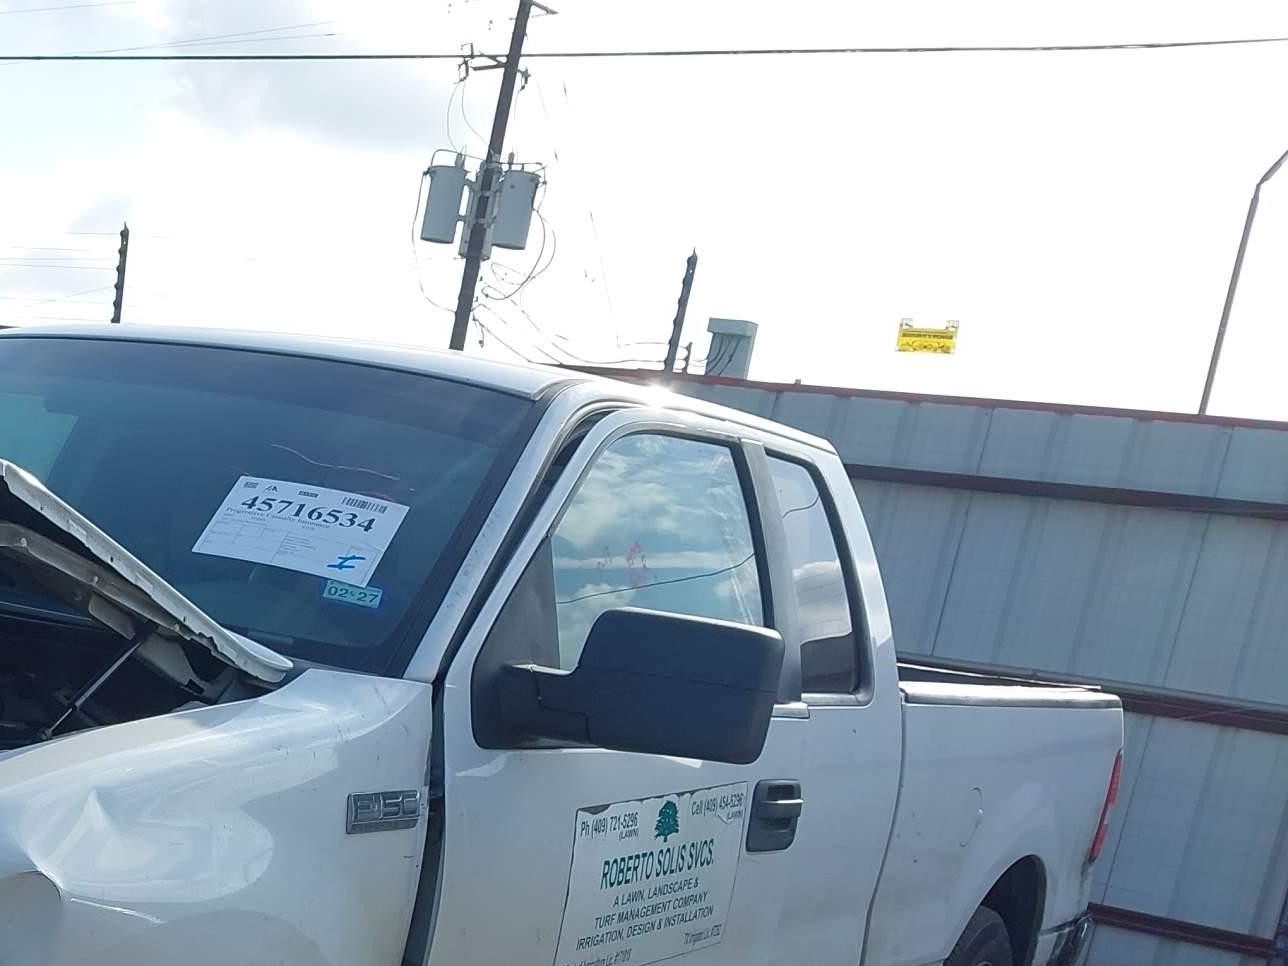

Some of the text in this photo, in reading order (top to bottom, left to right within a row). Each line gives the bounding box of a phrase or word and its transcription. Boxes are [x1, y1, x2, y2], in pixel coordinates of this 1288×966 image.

[241, 495, 376, 533] 45716534
[691, 799, 703, 817] Cell
[580, 811, 639, 840] Ph (409) 721-5296
[600, 851, 654, 890] ROBERTO
[654, 843, 686, 878] SOLIS
[612, 895, 620, 908] A
[647, 880, 692, 900] LANDSCAPE
[692, 878, 699, 889] &
[594, 891, 710, 930] TURF MANAGEMENT COMPANY
[626, 921, 656, 939] DESIGN
[656, 920, 663, 931] &
[663, 905, 714, 928] INSTALLATION
